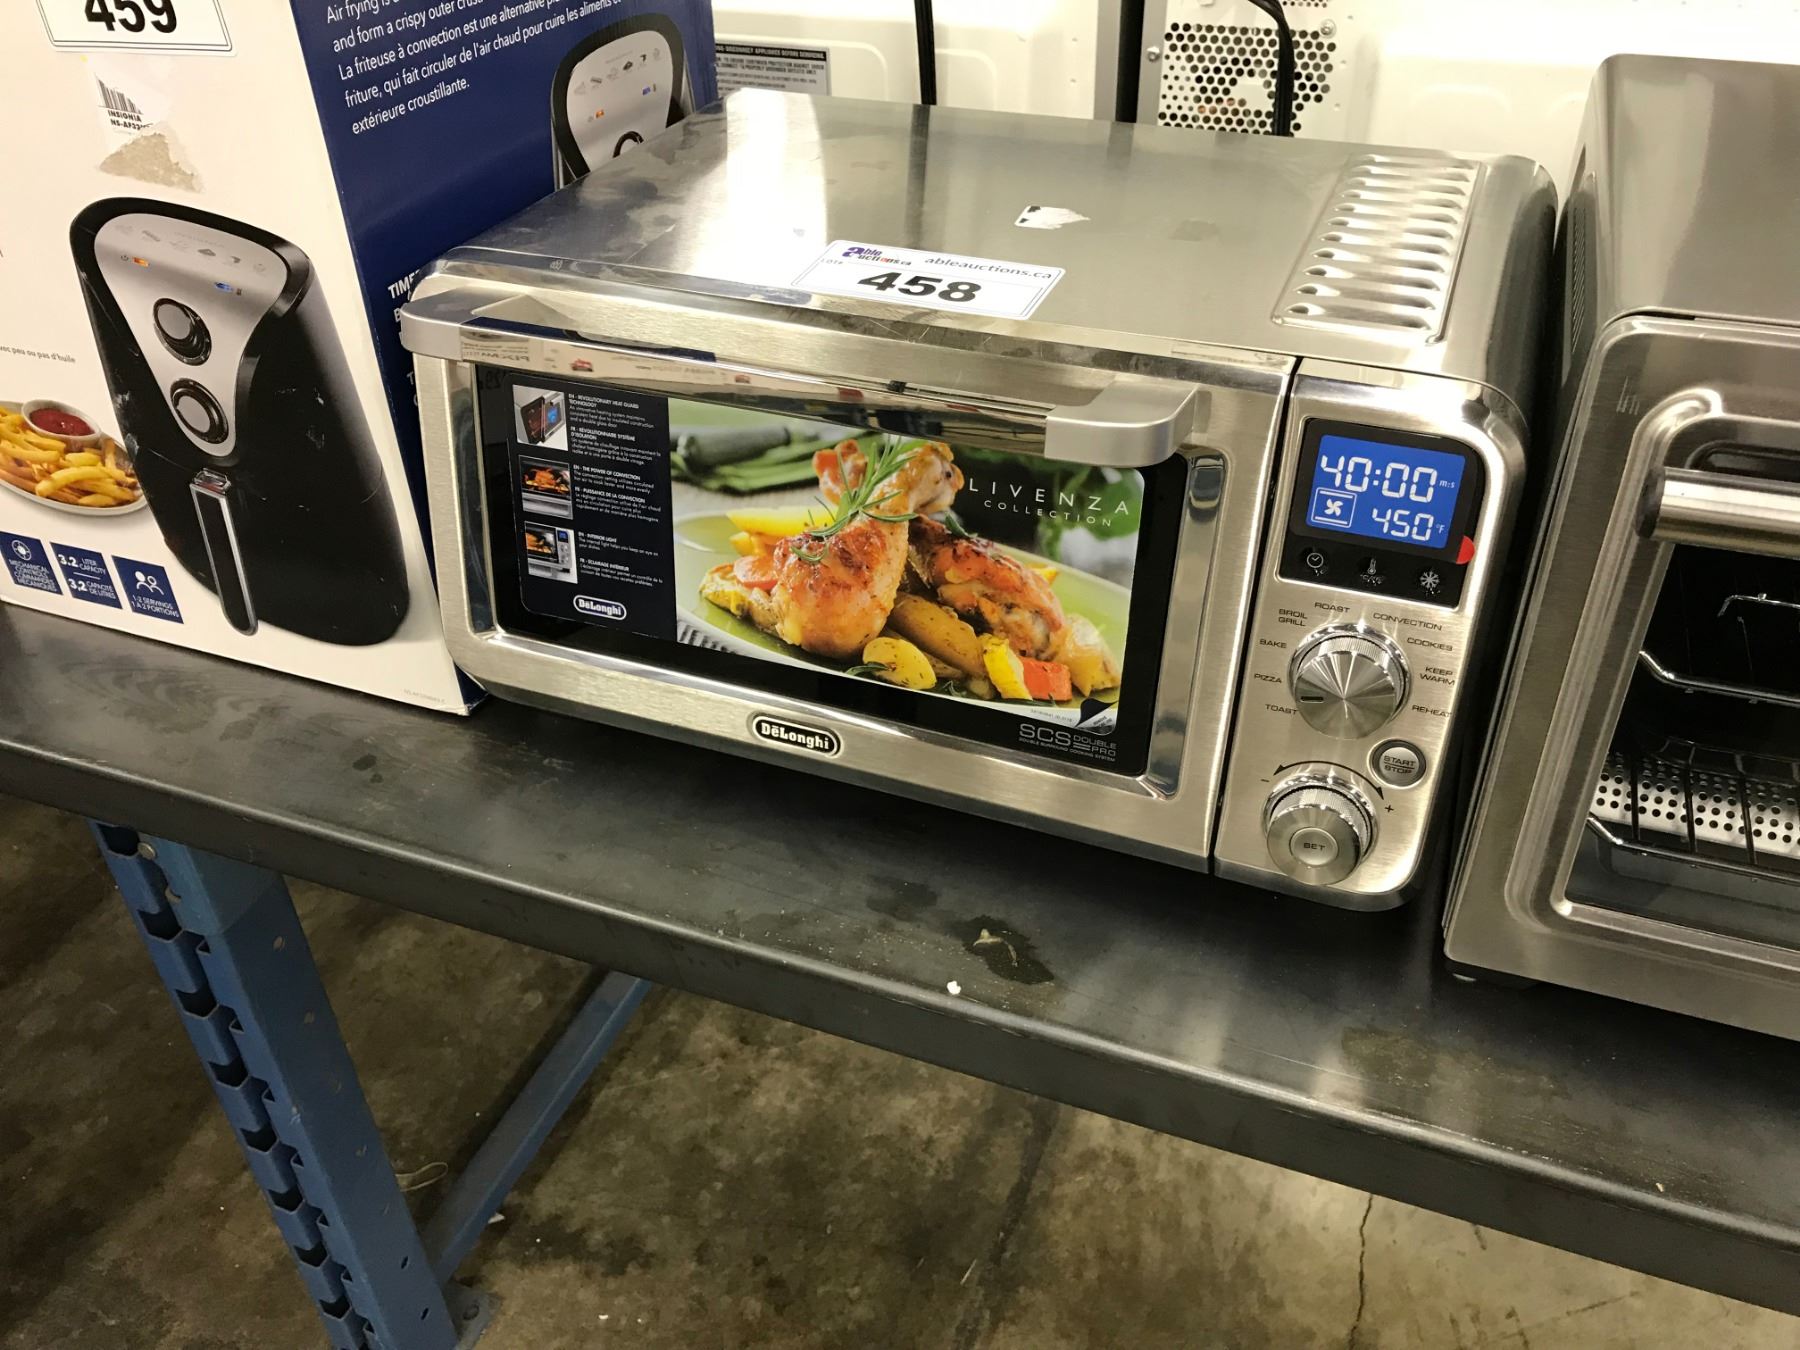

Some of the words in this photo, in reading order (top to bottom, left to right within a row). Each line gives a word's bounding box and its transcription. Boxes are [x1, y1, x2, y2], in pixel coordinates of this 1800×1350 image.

[84, 0, 178, 33] 459
[327, 5, 343, 24] Air
[345, 0, 380, 20] frying
[333, 29, 356, 53] and
[356, 25, 385, 44] form
[386, 22, 394, 34] a
[395, 10, 426, 30] crispy
[428, 1, 455, 20] outer
[338, 64, 354, 81] La
[354, 50, 396, 74] friteuse
[397, 43, 405, 59] à
[406, 26, 462, 56] convection
[463, 18, 479, 35] est
[479, 13, 498, 29] une
[499, 0, 545, 23] alternative
[344, 85, 382, 108] friture,
[383, 73, 402, 96] qui
[402, 67, 421, 86] fait
[421, 54, 457, 78] circuler
[459, 45, 473, 63] de
[474, 39, 491, 58] l'air
[493, 27, 522, 50] chaud
[522, 22, 543, 44] pour
[544, 12, 566, 31] cuire
[566, 8, 579, 22] les
[579, 0, 612, 17] aliments
[352, 103, 406, 135] extérieure
[407, 78, 470, 112] croustillante.
[924, 256, 1052, 279] ableauctions.ca
[857, 271, 982, 303] 458
[1320, 454, 1438, 503] 40:00
[968, 477, 1129, 516] LIVENZA
[984, 499, 1112, 527] COLLECTION
[1372, 506, 1435, 542] 450
[58, 554, 79, 568] 3.2
[1278, 608, 1308, 620] BROIL
[1314, 601, 1350, 614] ROAST
[1278, 615, 1307, 627] GRILL
[1372, 611, 1443, 631] CONVECTION
[1259, 638, 1288, 649] BAKE
[1406, 636, 1454, 652] COOKIES
[1254, 673, 1283, 684] PIZZA
[1425, 665, 1454, 677] KEEP
[1420, 672, 1456, 687] WARM
[1265, 703, 1298, 716] TOAST
[1411, 704, 1453, 717] REHEAT
[1019, 723, 1071, 746] SCS
[1073, 734, 1117, 750] DOUBLE
[1091, 745, 1116, 757] PRO
[1383, 755, 1416, 767] START
[1384, 764, 1413, 775] STOP
[1303, 842, 1326, 851] SET
